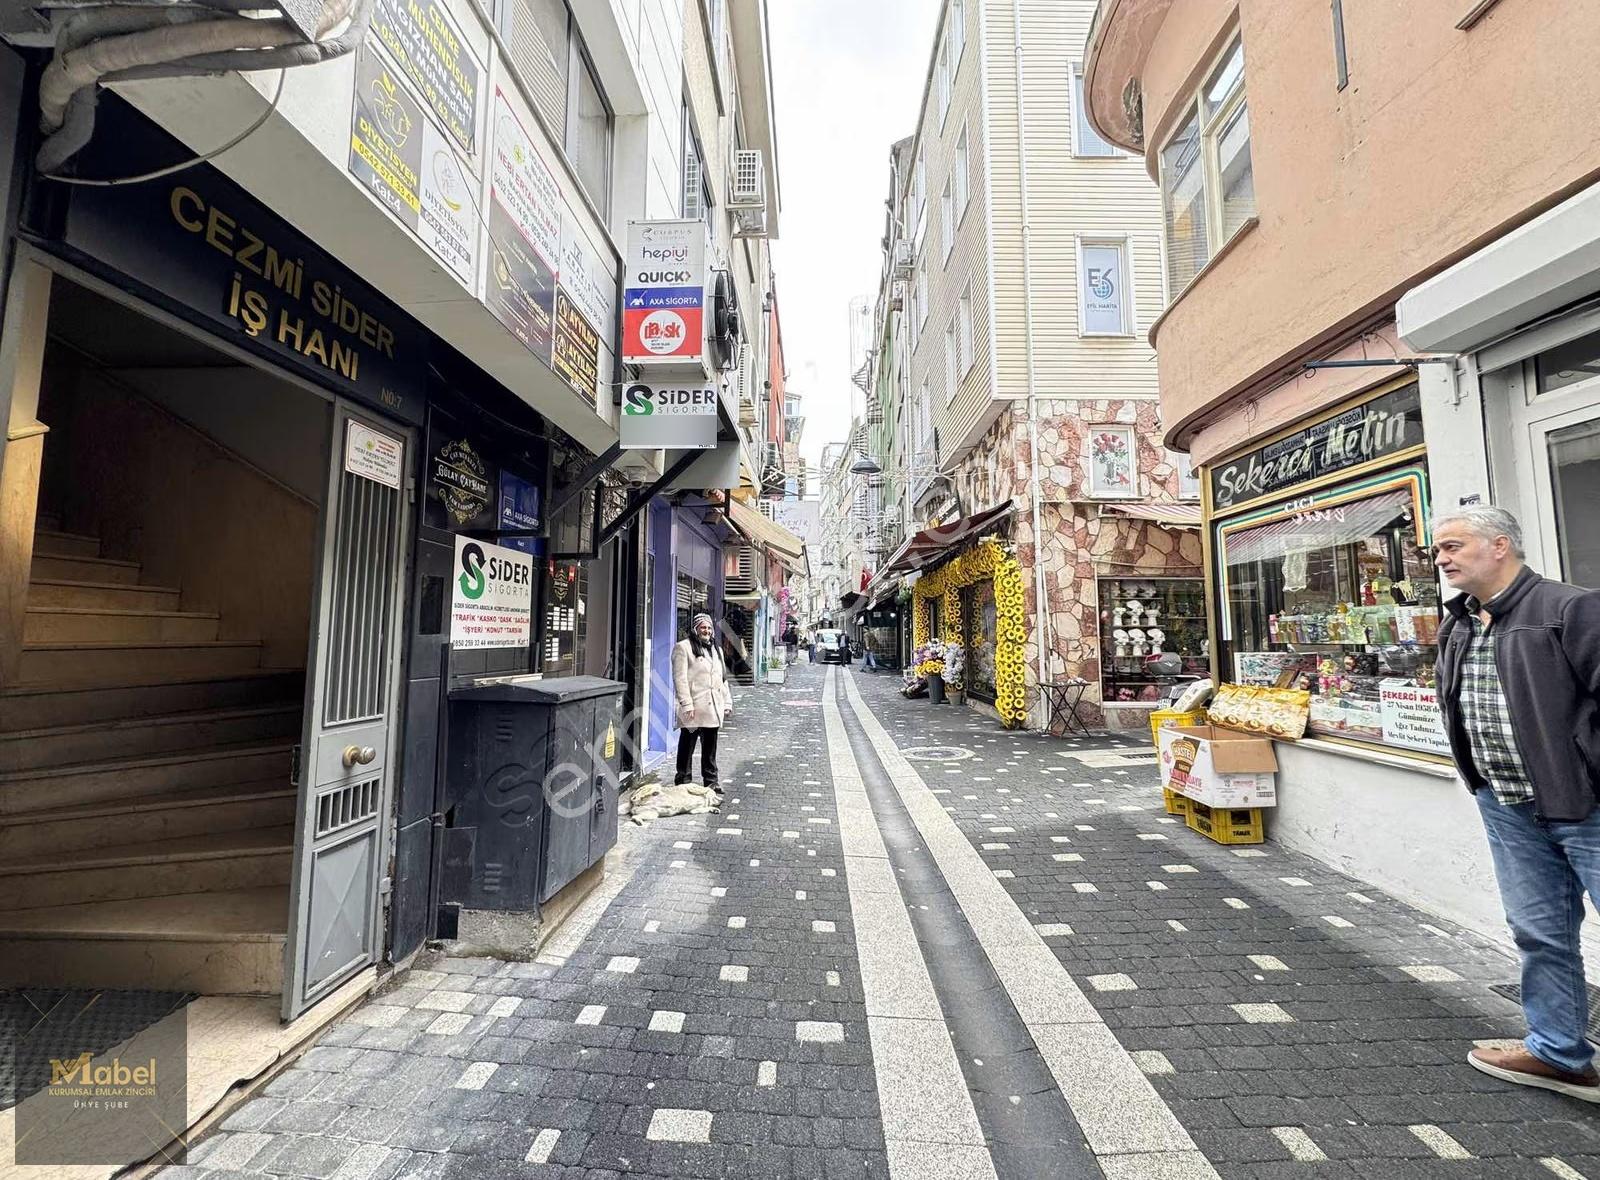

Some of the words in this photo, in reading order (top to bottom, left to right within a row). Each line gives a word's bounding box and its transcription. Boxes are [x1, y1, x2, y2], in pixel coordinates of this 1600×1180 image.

[429, 5, 460, 59] CEMRE
[359, 117, 418, 186] DİYETİSYEN
[370, 173, 401, 212] Kat:4
[643, 246, 688, 262] hepiyi
[170, 186, 305, 301] CEZMİ
[310, 280, 395, 360] SİDER
[638, 271, 684, 284] QUICK
[649, 297, 665, 305] AXA
[665, 296, 698, 305] SİGORTA
[228, 272, 268, 337] İŞ
[278, 307, 360, 382] HANI
[1216, 435, 1315, 509] Şekerci
[1321, 409, 1406, 466] Metin
[1382, 690, 1417, 701] ŞEKERCİ
[1395, 701, 1414, 711] Nisan
[1398, 712, 1436, 724] Günümüze
[1406, 734, 1427, 744] Şekeri
